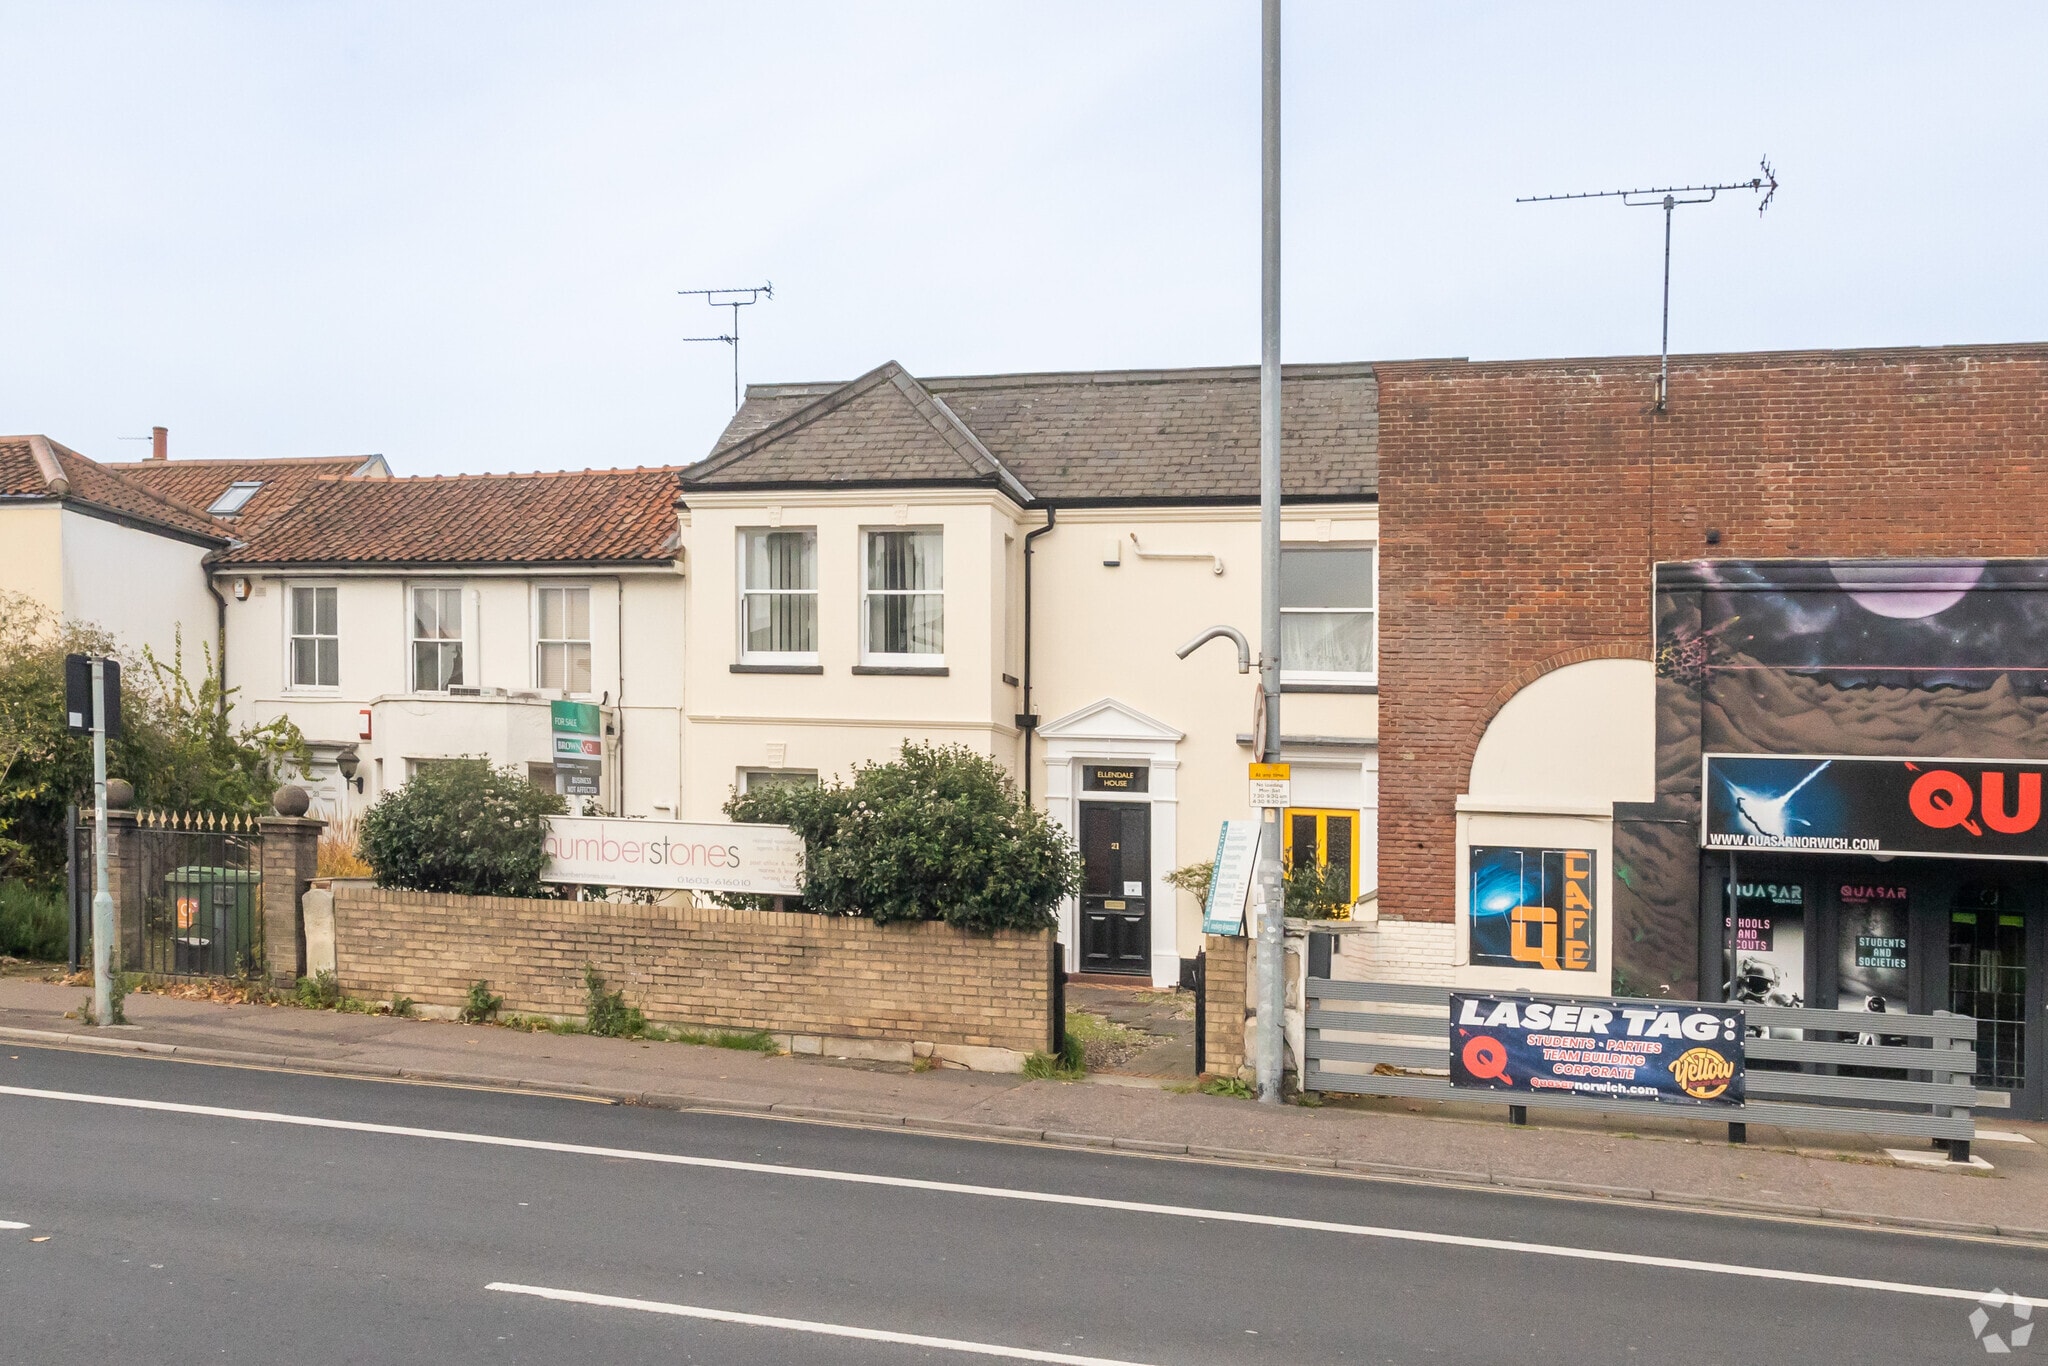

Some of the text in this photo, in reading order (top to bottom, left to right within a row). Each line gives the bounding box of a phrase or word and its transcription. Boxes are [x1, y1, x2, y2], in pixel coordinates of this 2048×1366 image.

[554, 717, 577, 727] FOR SALE
[572, 776, 592, 784] BUSINESS
[1097, 771, 1134, 779] ELLENDALE
[567, 785, 598, 794] NOT AFFECTED
[1710, 833, 1880, 850] WWW.QUASARNORWICH.COM
[1841, 885, 1907, 899] QUASAR
[1565, 850, 1593, 969] CAFE
[1725, 917, 1770, 929] SHOOLS
[1511, 906, 1562, 971] Q
[1738, 929, 1758, 939] AND
[1859, 937, 1906, 948] STUDENTS
[1873, 948, 1892, 957] AND
[1858, 957, 1907, 968] SOCIETIES
[1459, 1000, 1613, 1034] LASER
[1527, 1034, 1662, 1054] STUDENTS PARTIES
[1543, 1049, 1646, 1066] TEAM BUILDING
[1553, 1063, 1635, 1080] CORPORATE
[1668, 1058, 1734, 1090] Yellow
[1530, 1077, 1659, 1095] Quasarnorwich.com
